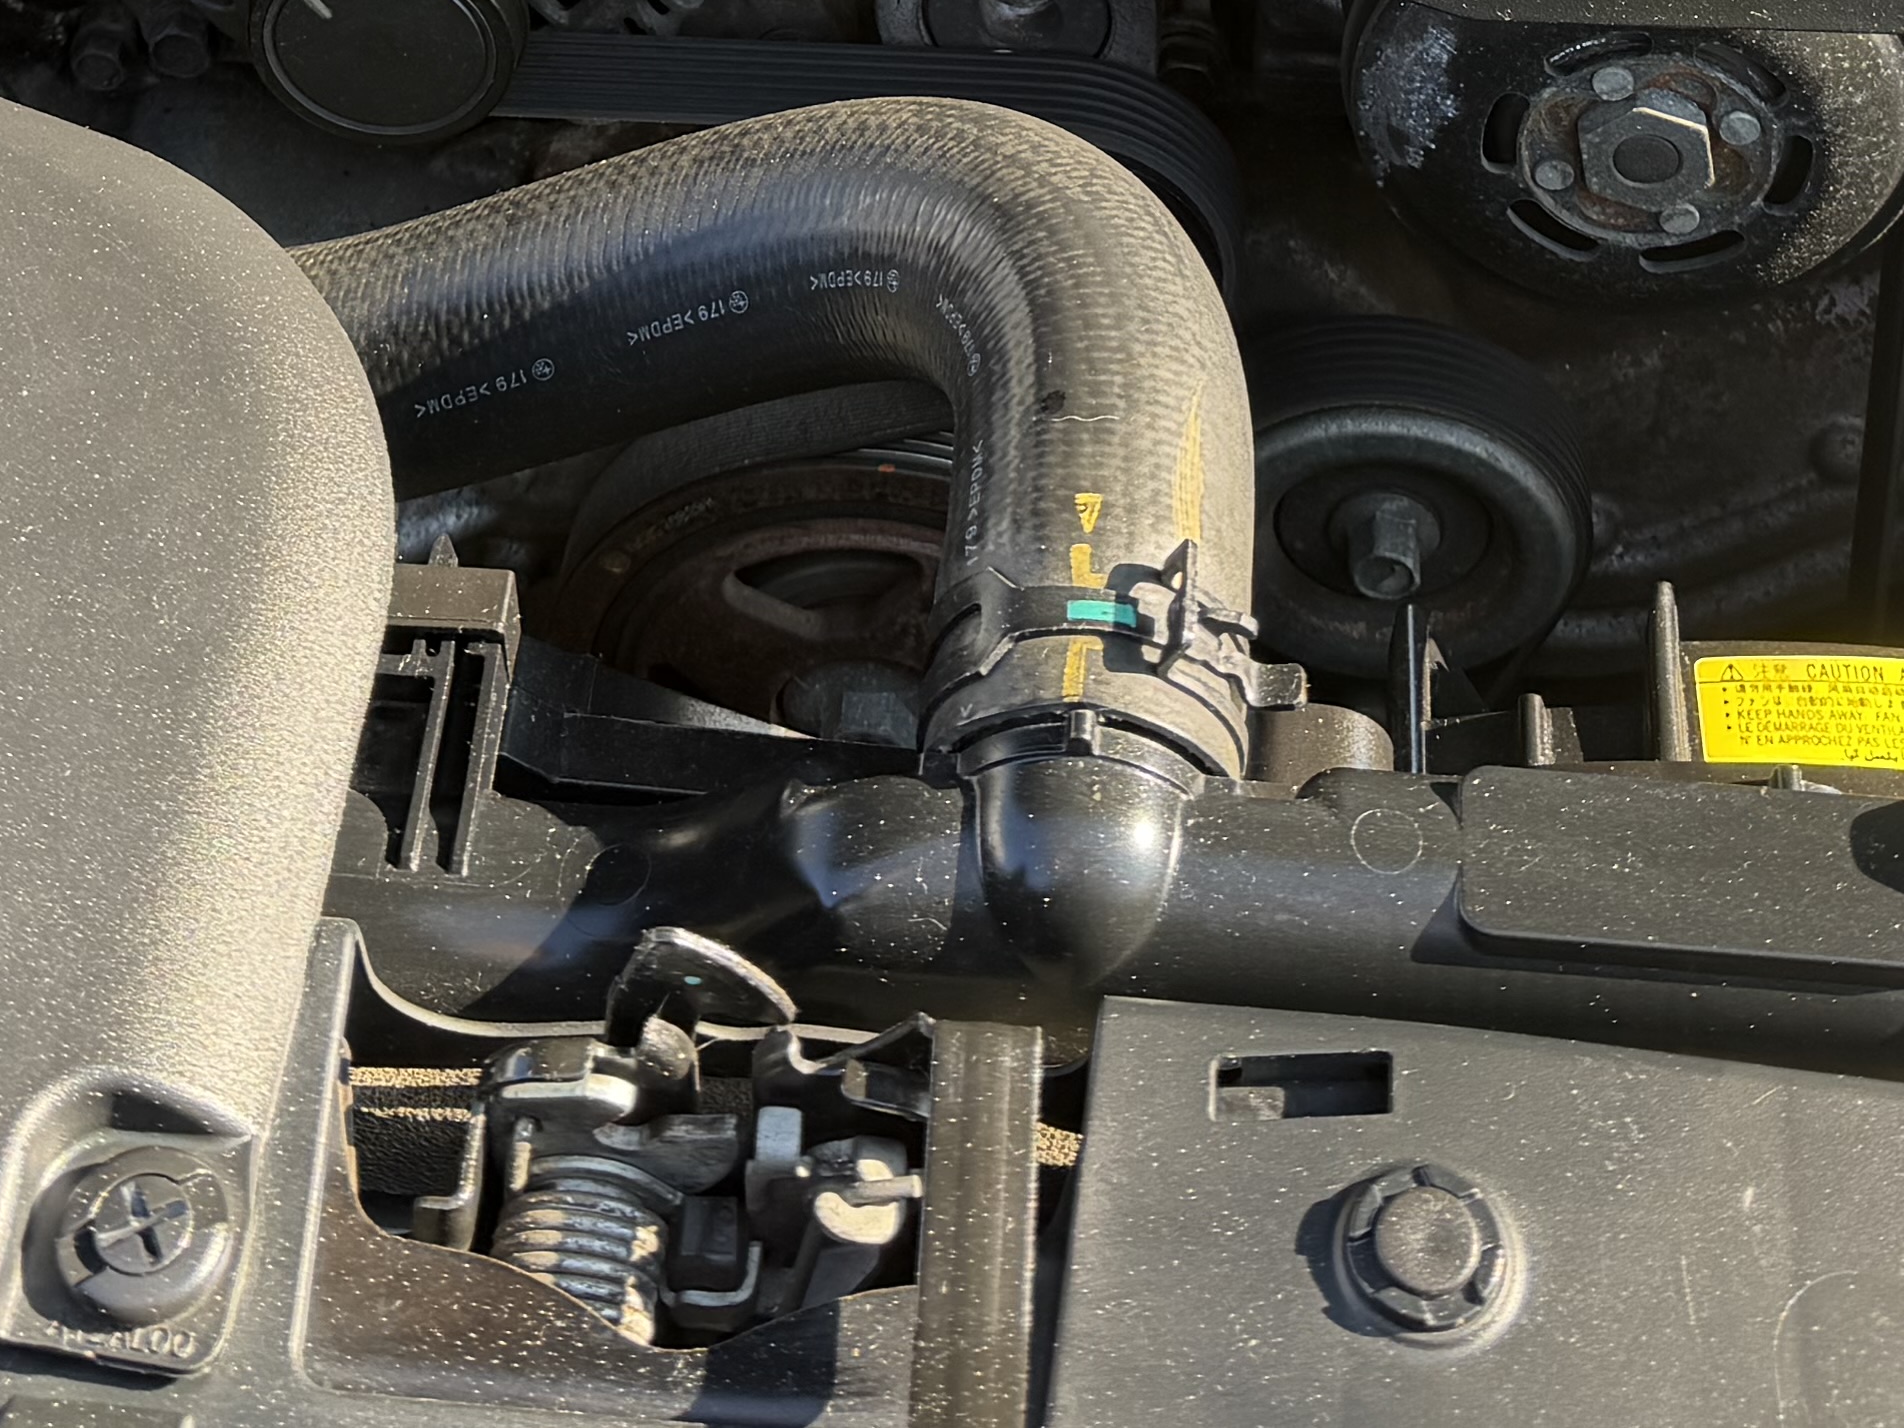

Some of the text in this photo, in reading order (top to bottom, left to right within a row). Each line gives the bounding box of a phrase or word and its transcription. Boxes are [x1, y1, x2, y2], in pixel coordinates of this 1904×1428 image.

[1806, 663, 1885, 682] CAUTION
[1737, 709, 1772, 721] KEEP
[1777, 709, 1826, 721] HANDS
[1875, 711, 1901, 723] FAN
